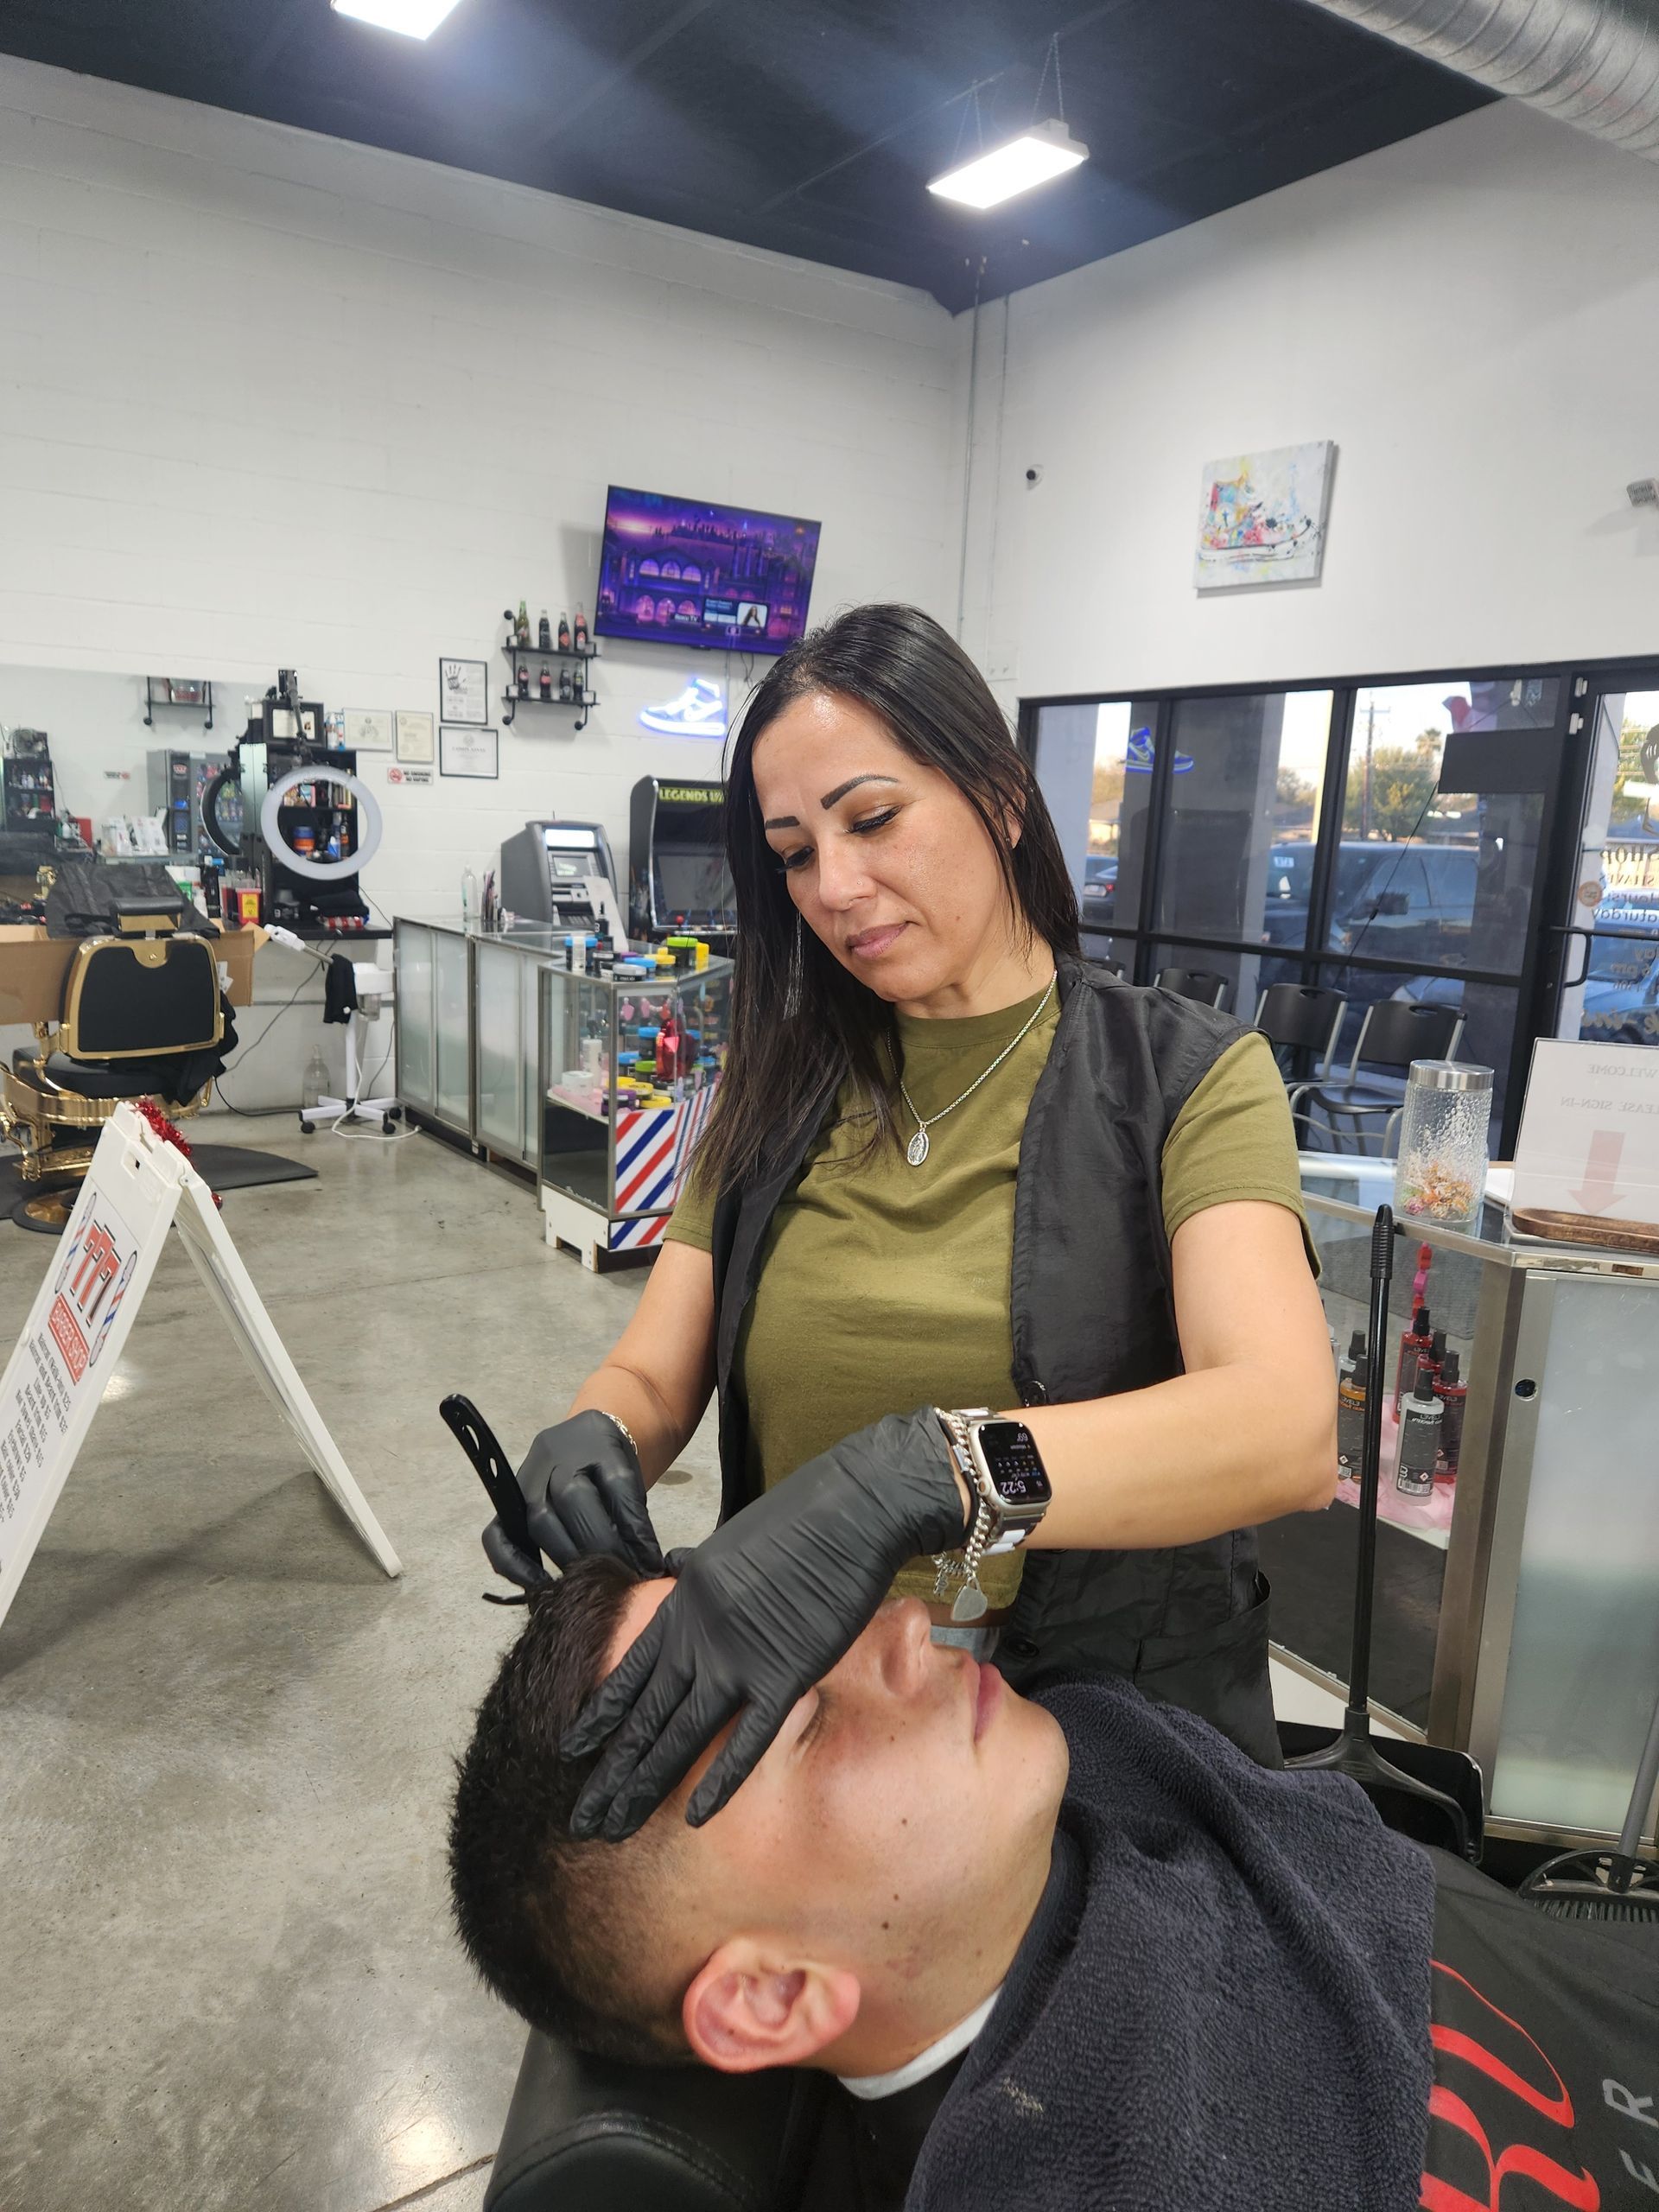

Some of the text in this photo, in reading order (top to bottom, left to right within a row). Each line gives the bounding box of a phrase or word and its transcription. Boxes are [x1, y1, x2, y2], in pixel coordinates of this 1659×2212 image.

[659, 787, 709, 804] LEGENDS
[70, 1219, 121, 1329] 777
[1000, 1480, 1027, 1494] 5:22
